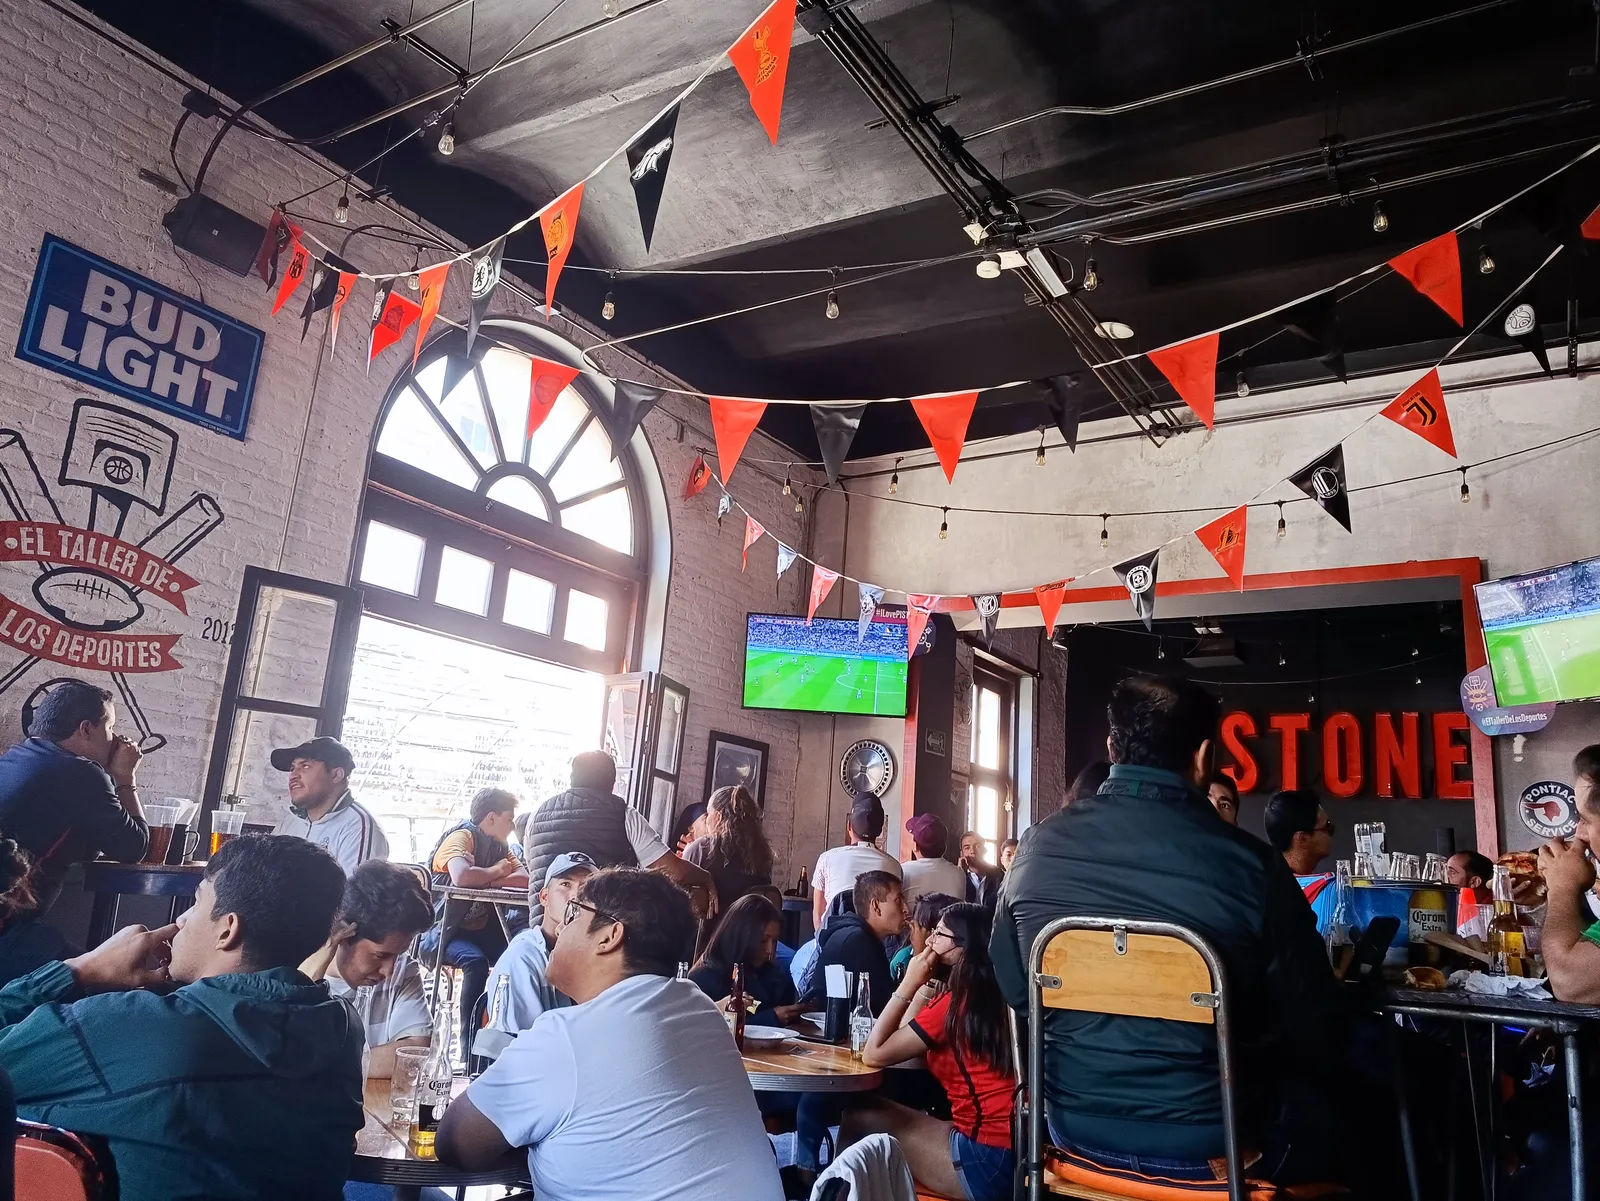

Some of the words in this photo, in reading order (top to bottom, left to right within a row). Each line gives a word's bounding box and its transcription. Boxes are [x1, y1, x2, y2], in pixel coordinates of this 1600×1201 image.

[80, 269, 221, 362] BUD
[39, 304, 239, 419] LIGHT
[19, 526, 51, 557] EL
[58, 529, 139, 579] TALLER
[140, 564, 173, 592] DE
[0, 608, 52, 650] LOS
[51, 633, 163, 668] DEPORTES
[1219, 710, 1475, 799] STONE
[1525, 784, 1576, 804] PONTIAC
[1526, 817, 1578, 838] SERVICE
[1421, 922, 1442, 932] Extra
[428, 1079, 452, 1092] Coro
